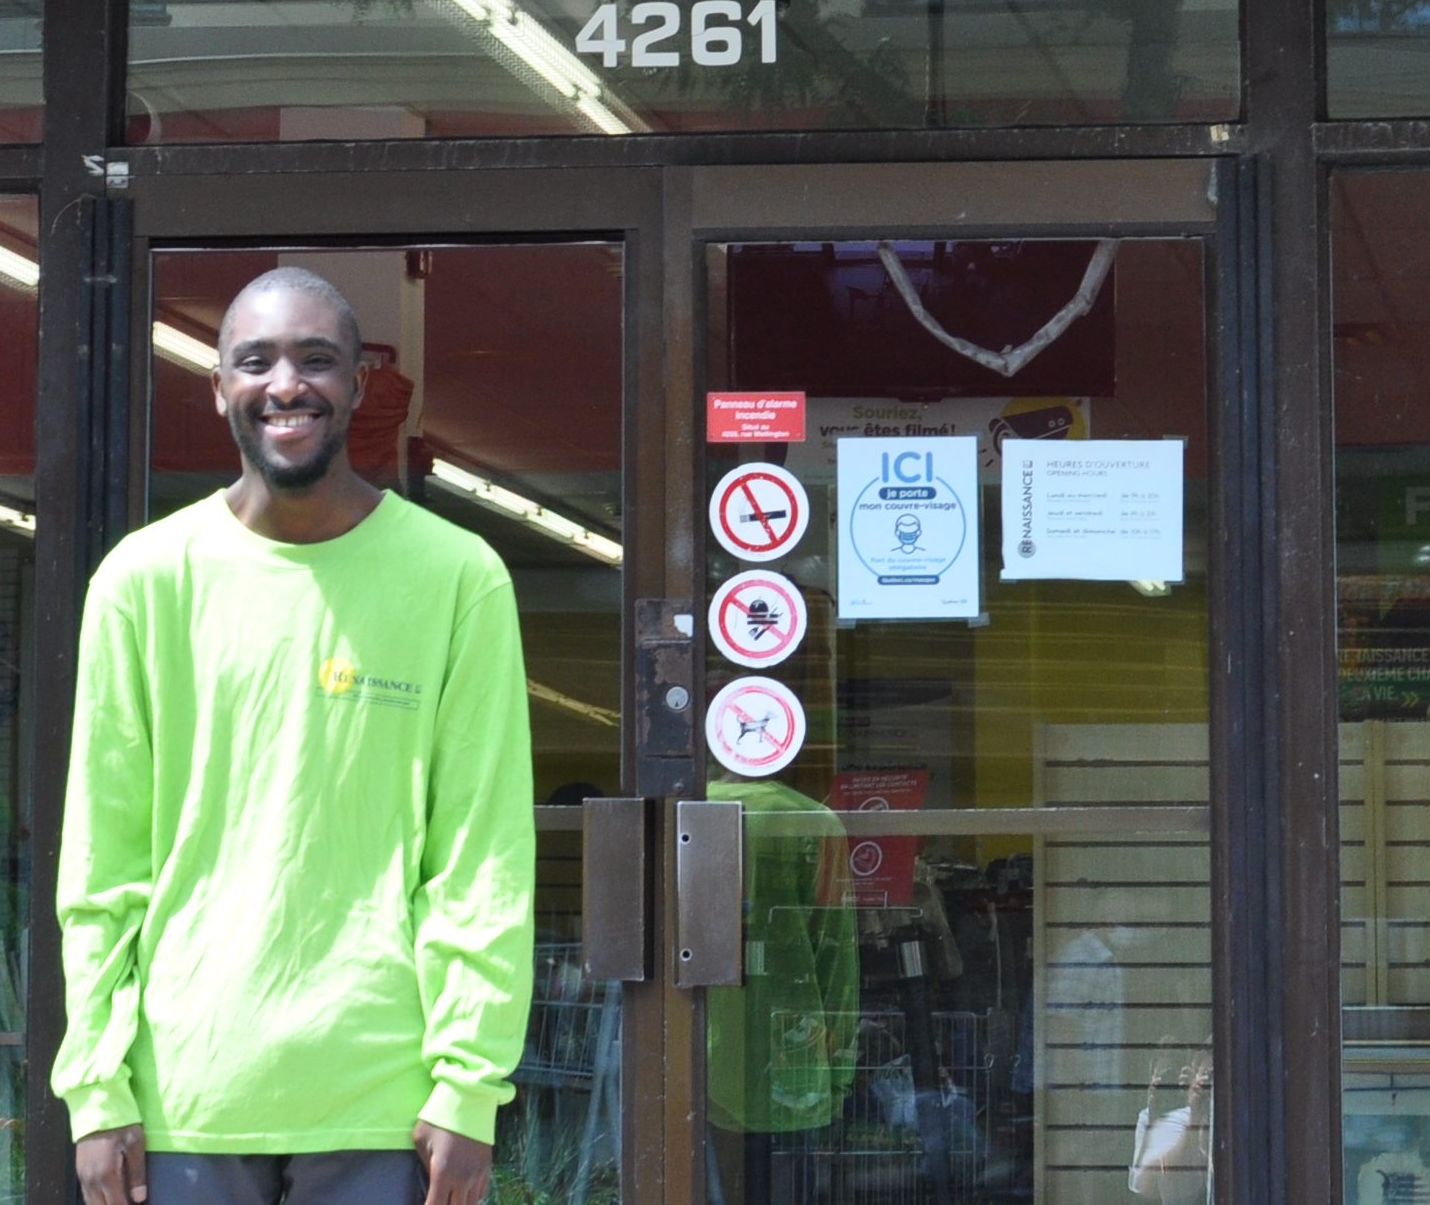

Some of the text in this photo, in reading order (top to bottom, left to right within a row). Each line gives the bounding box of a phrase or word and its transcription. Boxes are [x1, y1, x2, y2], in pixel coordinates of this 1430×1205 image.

[575, 0, 777, 68] 4261
[863, 422, 900, 437] êtes
[882, 451, 933, 483] ICI
[886, 488, 929, 499] je porte
[884, 501, 957, 511] couvre-visage
[1023, 470, 1033, 554] RENAISSANCE
